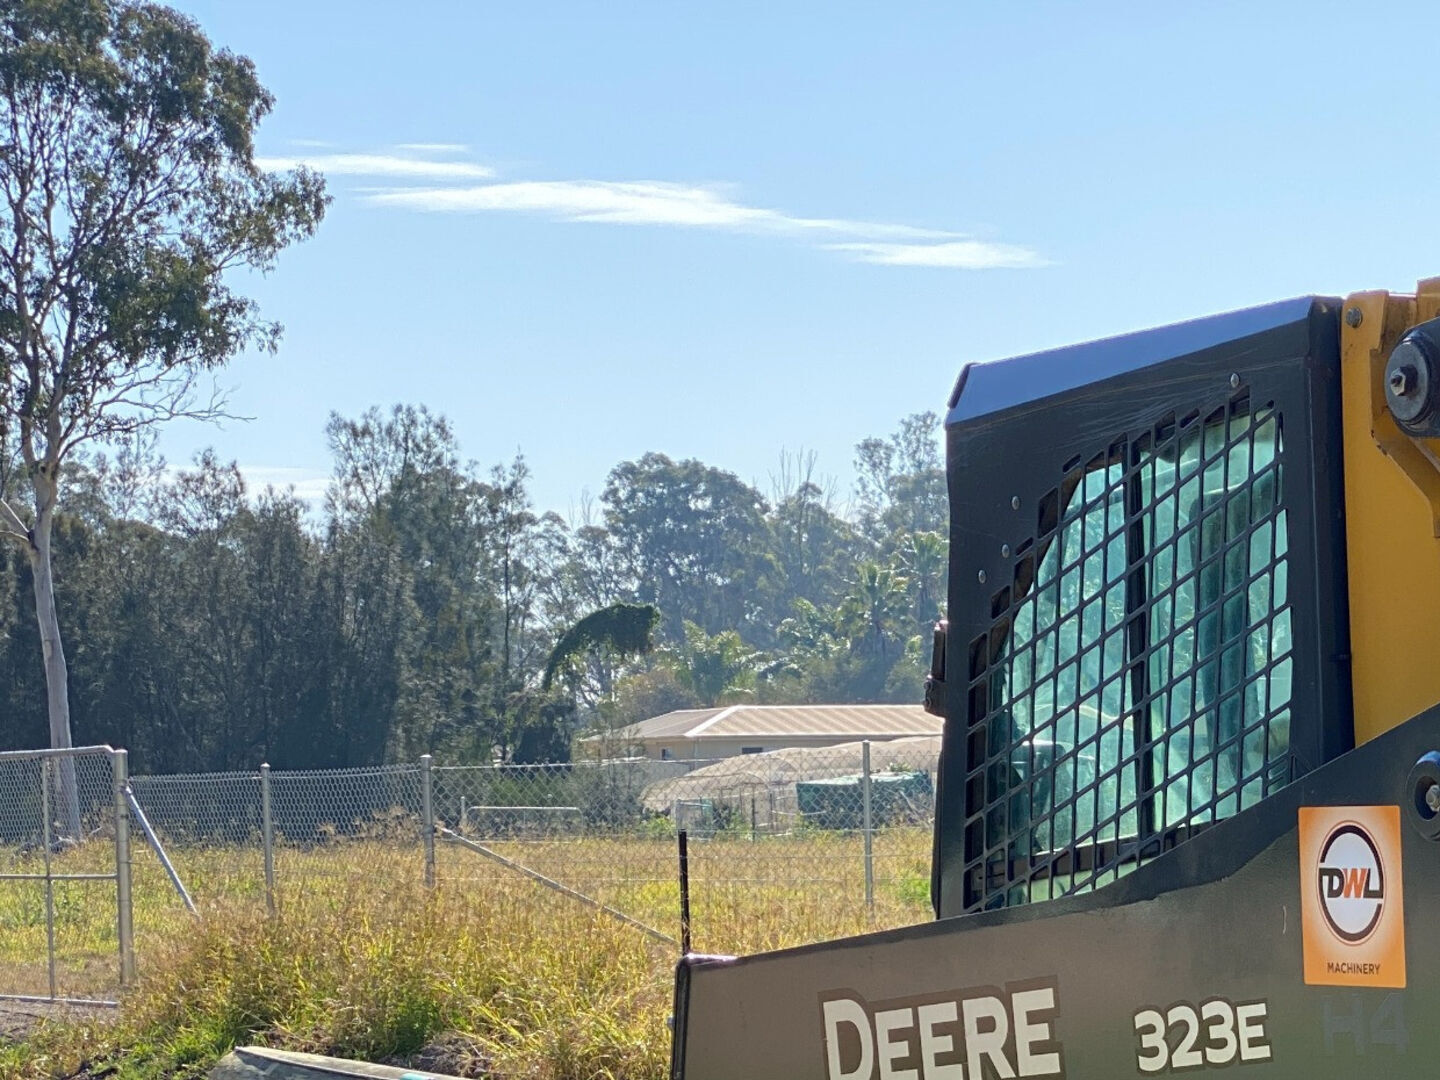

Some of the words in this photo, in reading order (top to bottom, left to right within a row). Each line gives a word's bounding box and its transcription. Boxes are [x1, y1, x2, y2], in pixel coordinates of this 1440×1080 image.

[1318, 867, 1384, 899] DWL
[1327, 961, 1381, 976] MACHINERY
[1134, 1000, 1272, 1072] 323E
